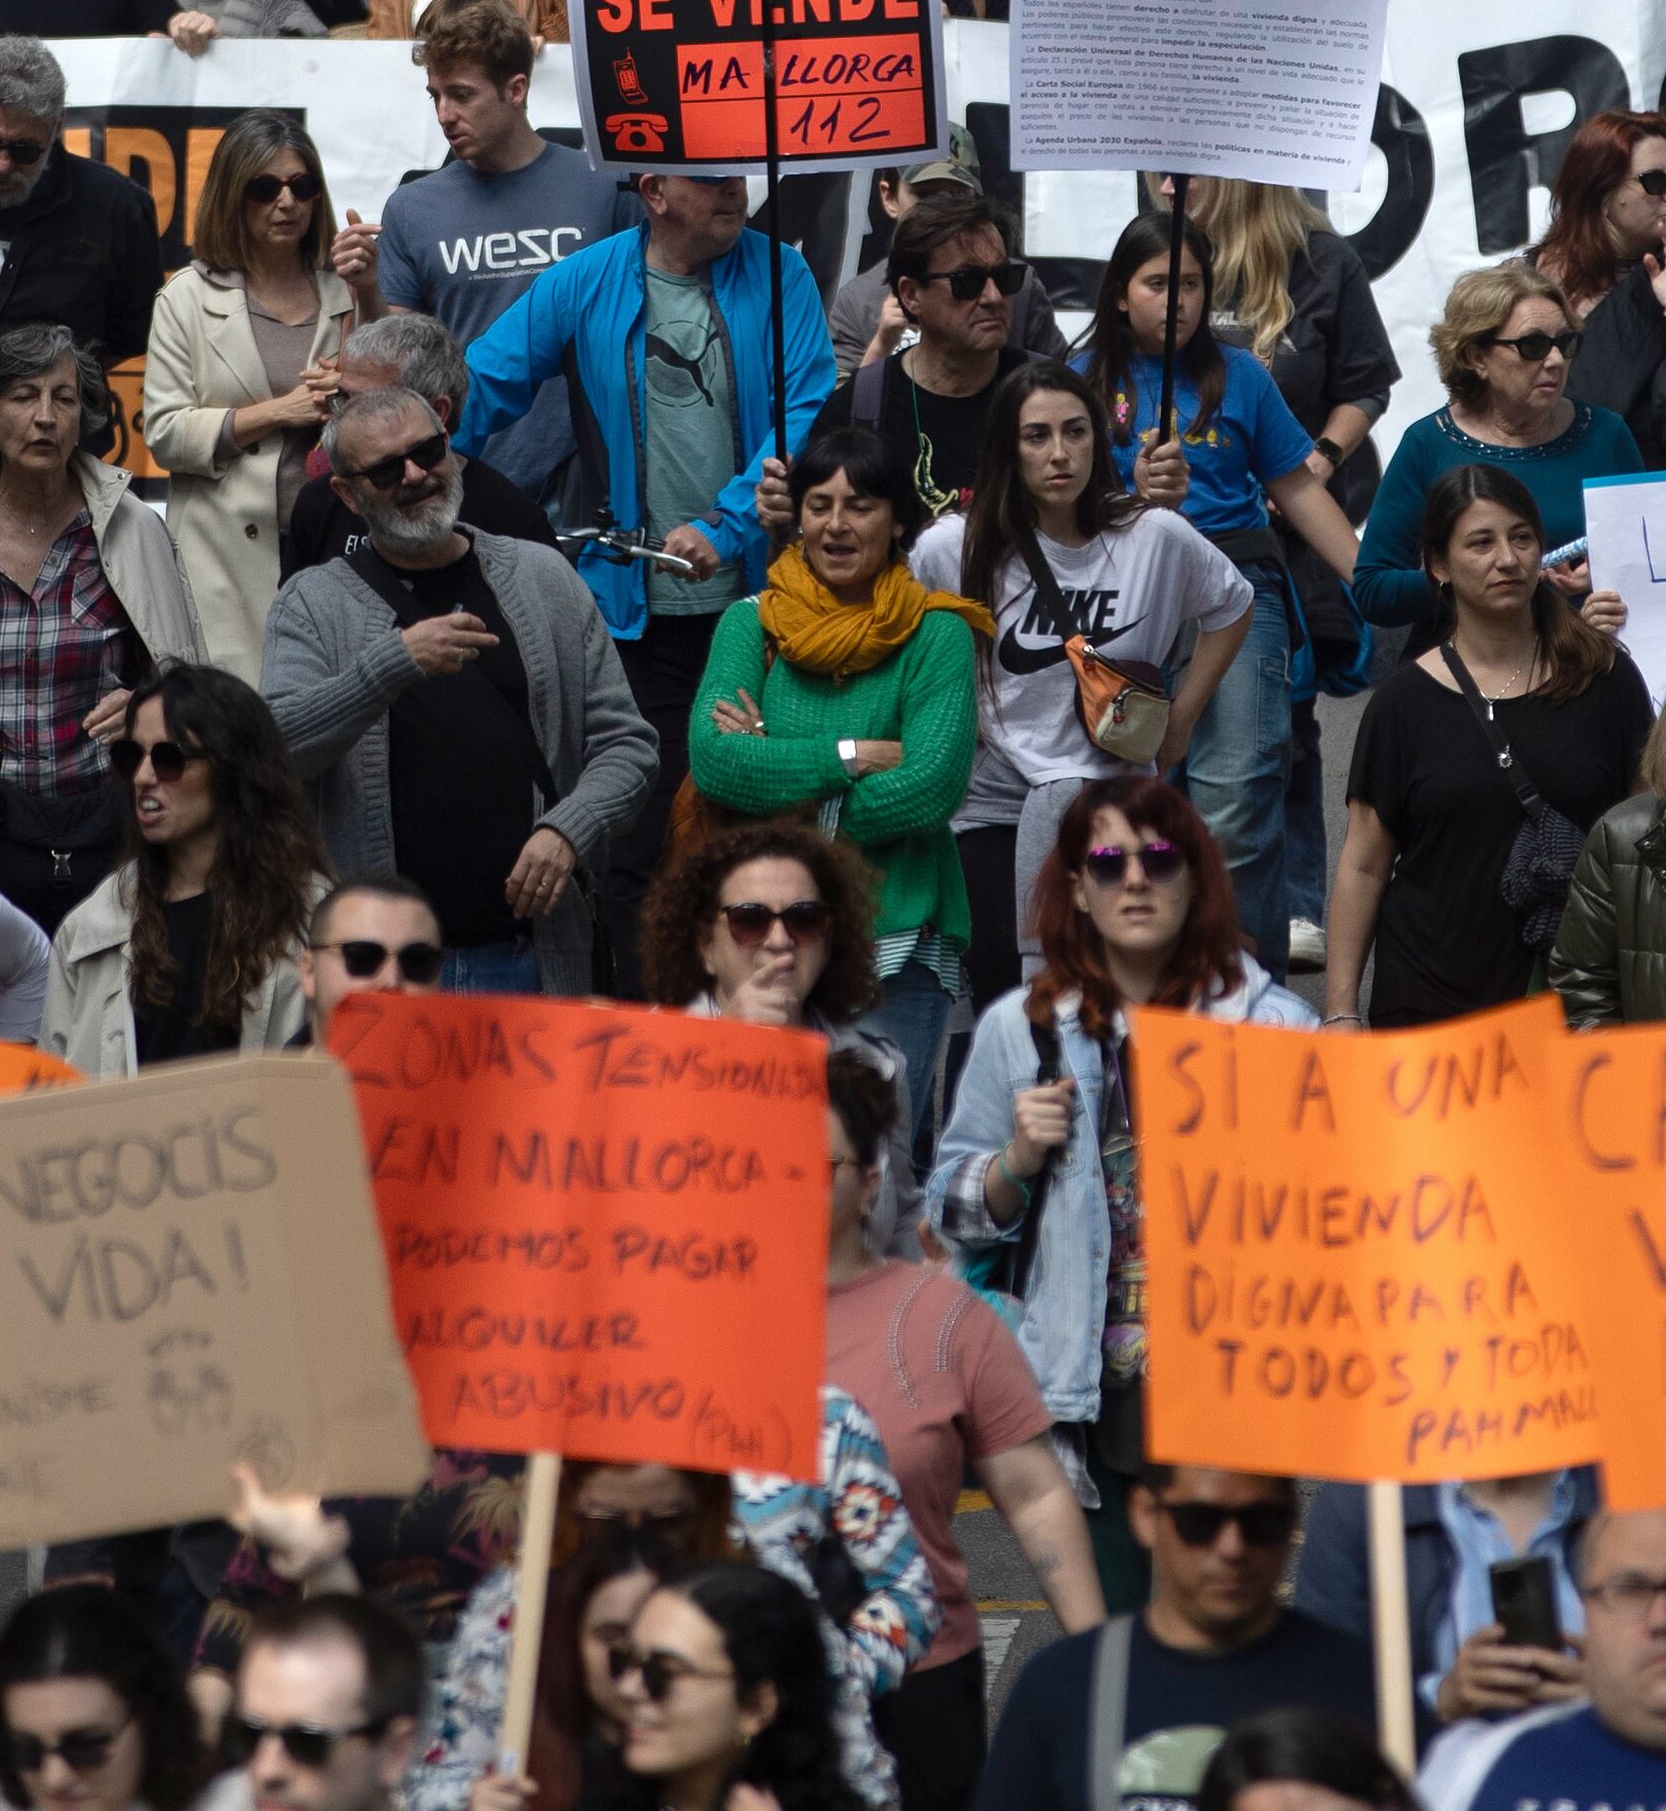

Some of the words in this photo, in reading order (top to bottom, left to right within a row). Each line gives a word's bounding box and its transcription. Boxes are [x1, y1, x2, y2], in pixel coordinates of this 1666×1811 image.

[1161, 37, 1195, 48] impedir
[1198, 39, 1205, 47] la
[1208, 40, 1267, 52] especulación.
[1036, 80, 1058, 88] Carta
[1088, 81, 1123, 90] Europea
[1070, 91, 1077, 99] la
[1203, 73, 1241, 83] vivienda.
[1262, 91, 1298, 101] medidas
[1299, 96, 1319, 105] para
[1322, 97, 1361, 109] favorecer
[788, 95, 893, 148] 112
[1035, 136, 1064, 145] Agenda
[1067, 136, 1097, 144] Urbana
[1123, 137, 1166, 147] Española,
[1213, 142, 1251, 155] políticas
[1266, 148, 1298, 159] materia
[1312, 153, 1345, 164] vivienda
[1020, 588, 1120, 638] NKE
[332, 1000, 557, 1090] ZONAS
[1288, 1048, 1337, 1133] A
[1386, 1028, 1531, 1122] UNA
[372, 1115, 462, 1186] EN
[491, 1128, 767, 1197] MALLORCA
[16, 1220, 253, 1325] VIDA!
[394, 1223, 591, 1273] PODEMOS
[610, 1226, 760, 1283] PAGAR
[407, 1305, 645, 1354] ALQUILER
[449, 1366, 689, 1426] ABUSIVO
[1215, 1335, 1417, 1409] TODOS
[1441, 1342, 1462, 1392] Y
[1405, 1401, 1504, 1466] PAH
